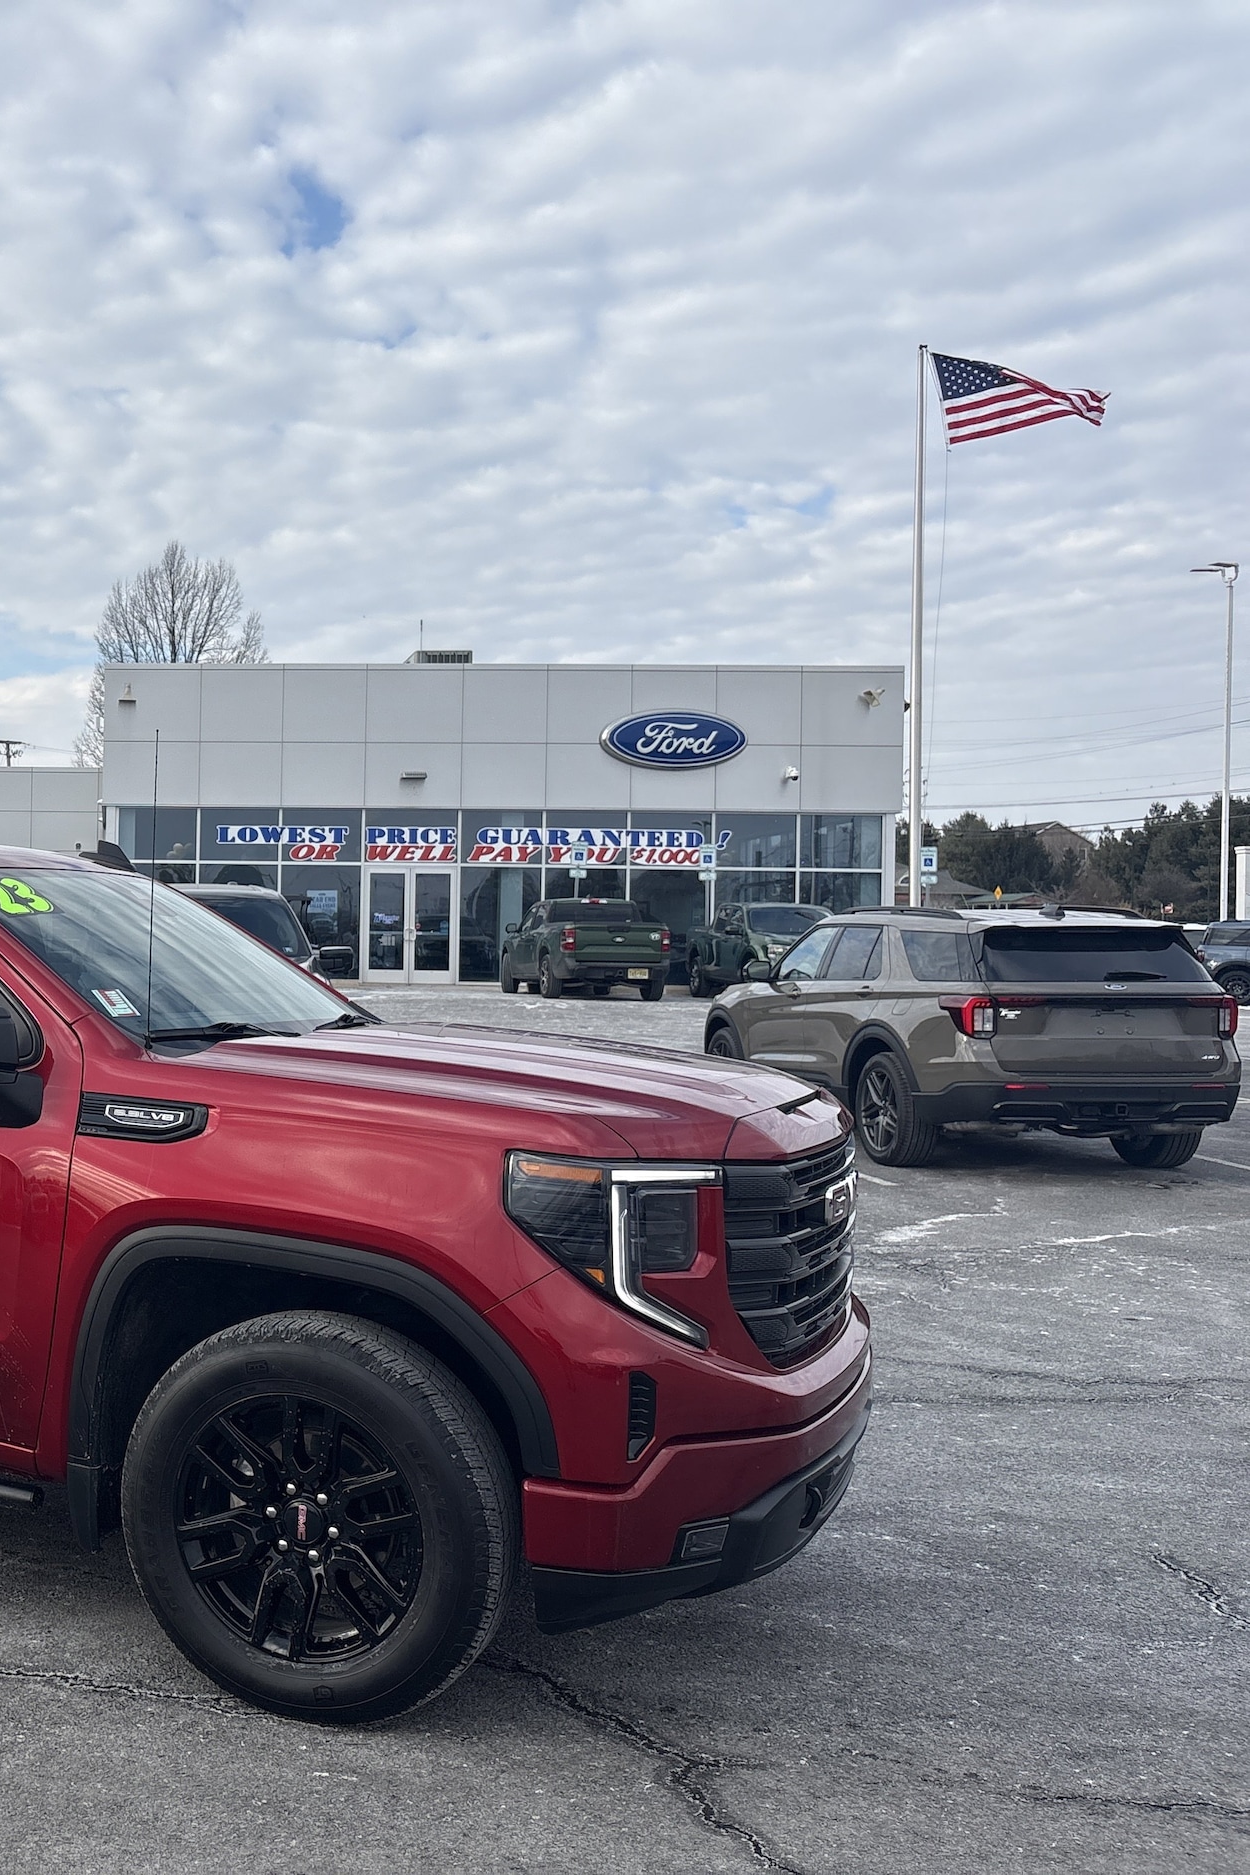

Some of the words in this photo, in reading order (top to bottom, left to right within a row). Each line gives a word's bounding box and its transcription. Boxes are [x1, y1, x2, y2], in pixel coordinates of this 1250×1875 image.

[636, 721, 719, 755] Ford
[216, 826, 348, 844] LOWEST
[366, 828, 456, 845] PRICE
[290, 844, 341, 861] OR
[467, 846, 540, 863] PAY
